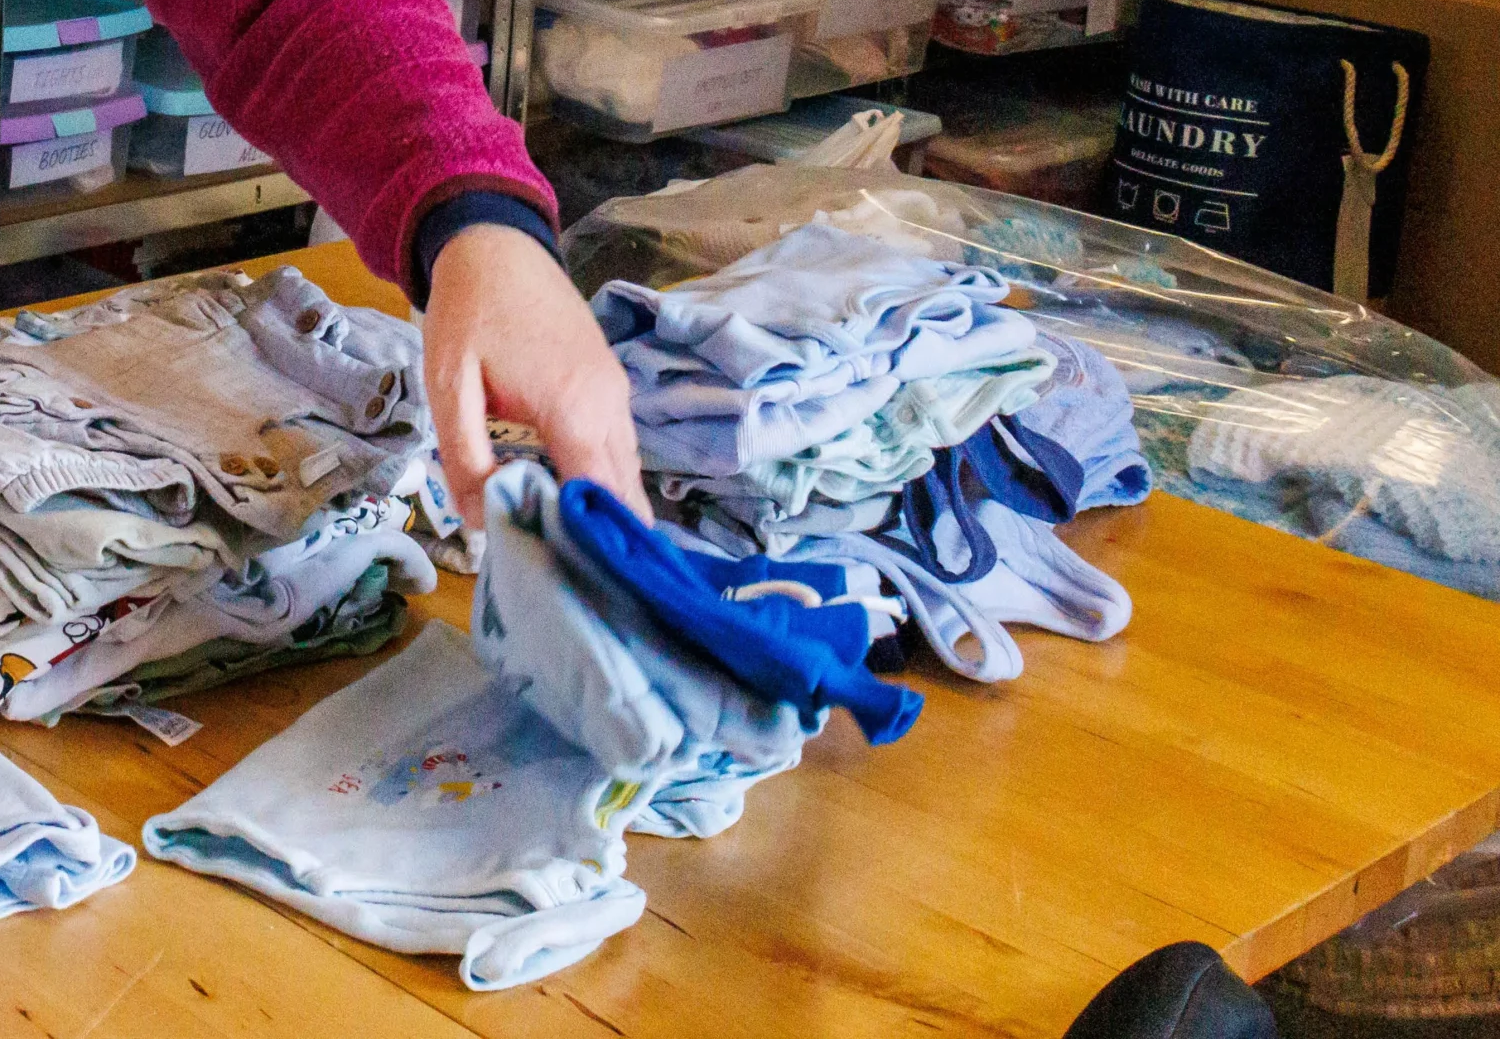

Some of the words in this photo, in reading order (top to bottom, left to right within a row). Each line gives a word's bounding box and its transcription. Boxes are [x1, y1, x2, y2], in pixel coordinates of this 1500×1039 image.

[1155, 82, 1200, 107] WITH
[1203, 93, 1259, 114] CARE
[38, 139, 99, 171] BOOTIES
[1130, 147, 1180, 169] DELICATE
[1181, 162, 1225, 178] GOODS
